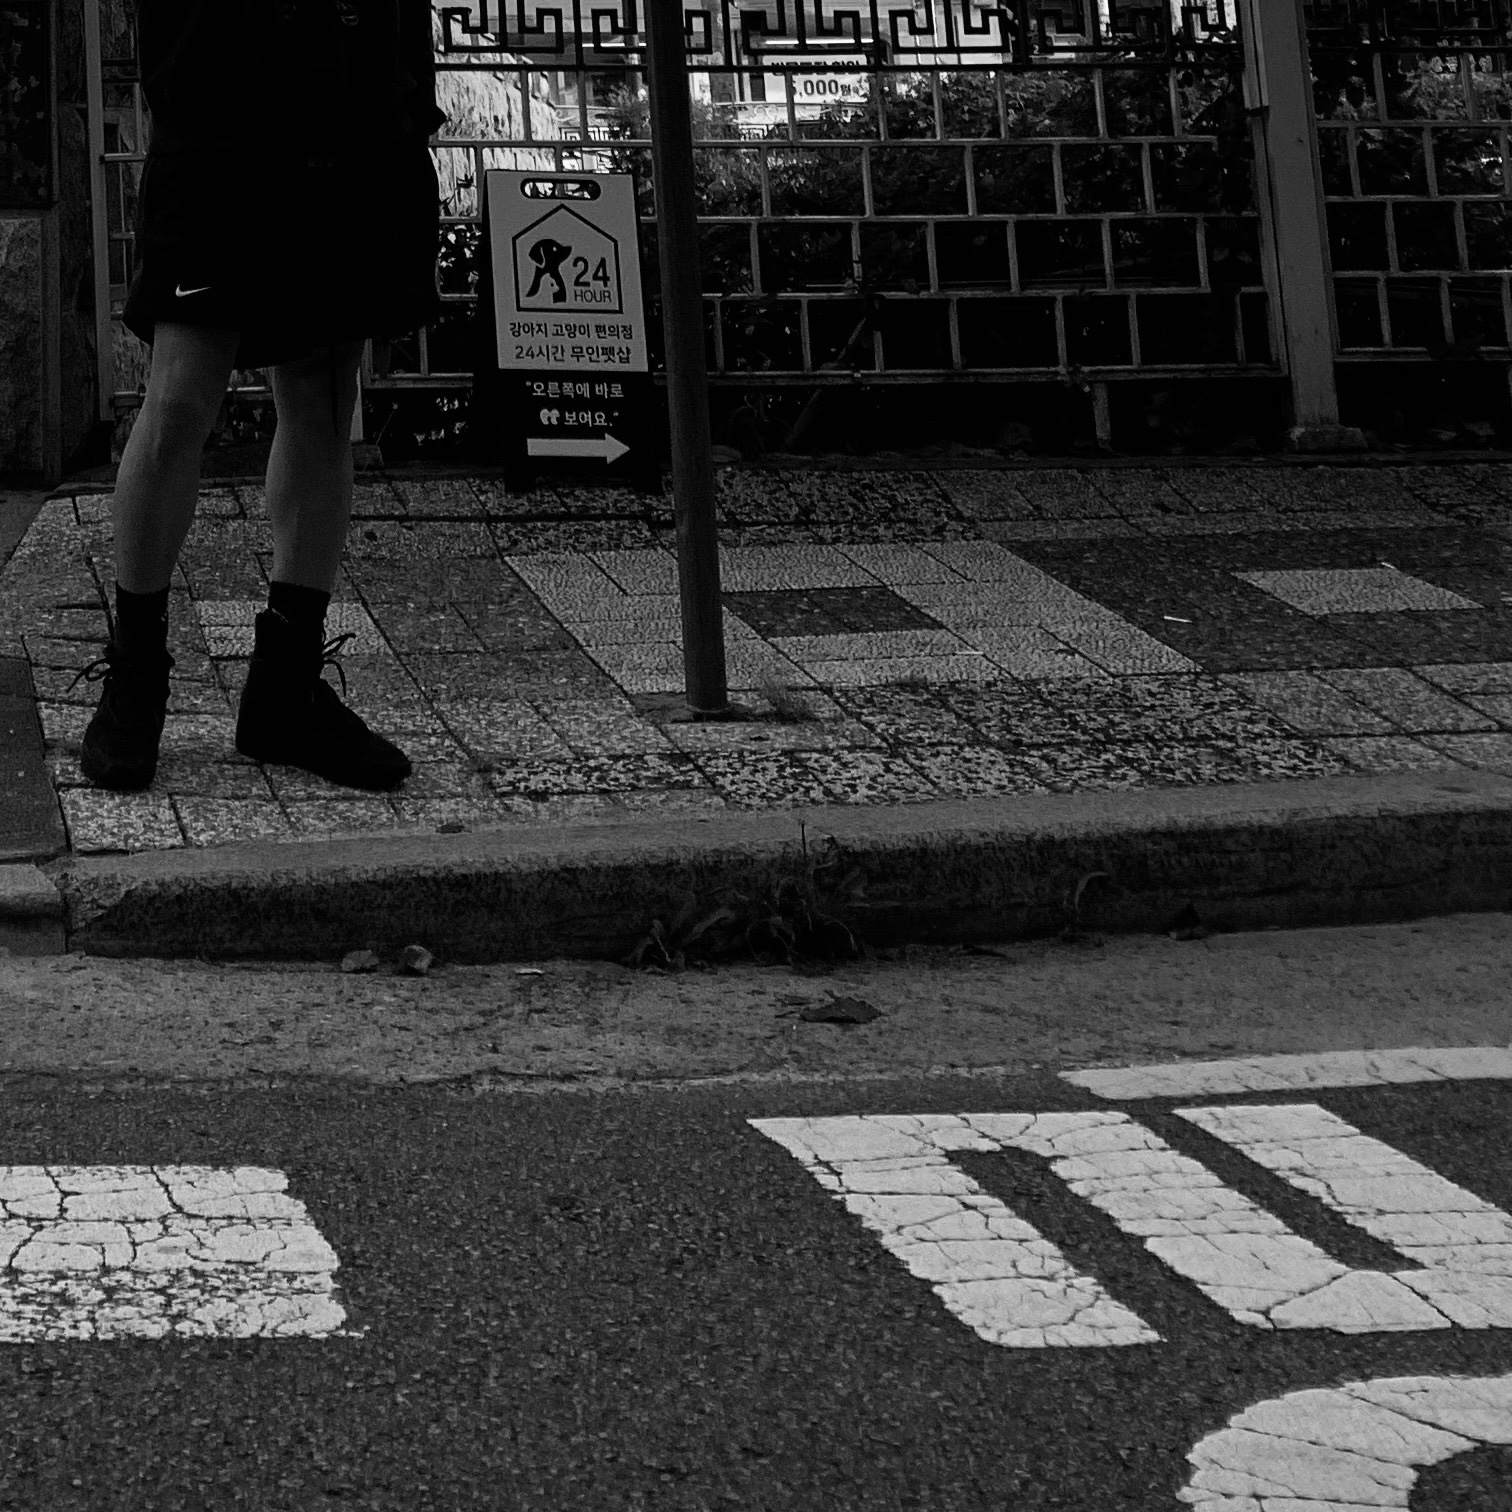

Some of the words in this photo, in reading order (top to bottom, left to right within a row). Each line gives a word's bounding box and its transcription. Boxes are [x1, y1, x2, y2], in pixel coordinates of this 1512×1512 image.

[571, 256, 611, 289] 24
[574, 289, 613, 304] HOUR
[509, 322, 548, 338] 강아지
[551, 322, 591, 338] 고양이
[595, 324, 633, 339] 편의점
[515, 345, 566, 363] 24시간
[570, 345, 632, 364] 무인펫샵
[595, 382, 624, 398] 바로
